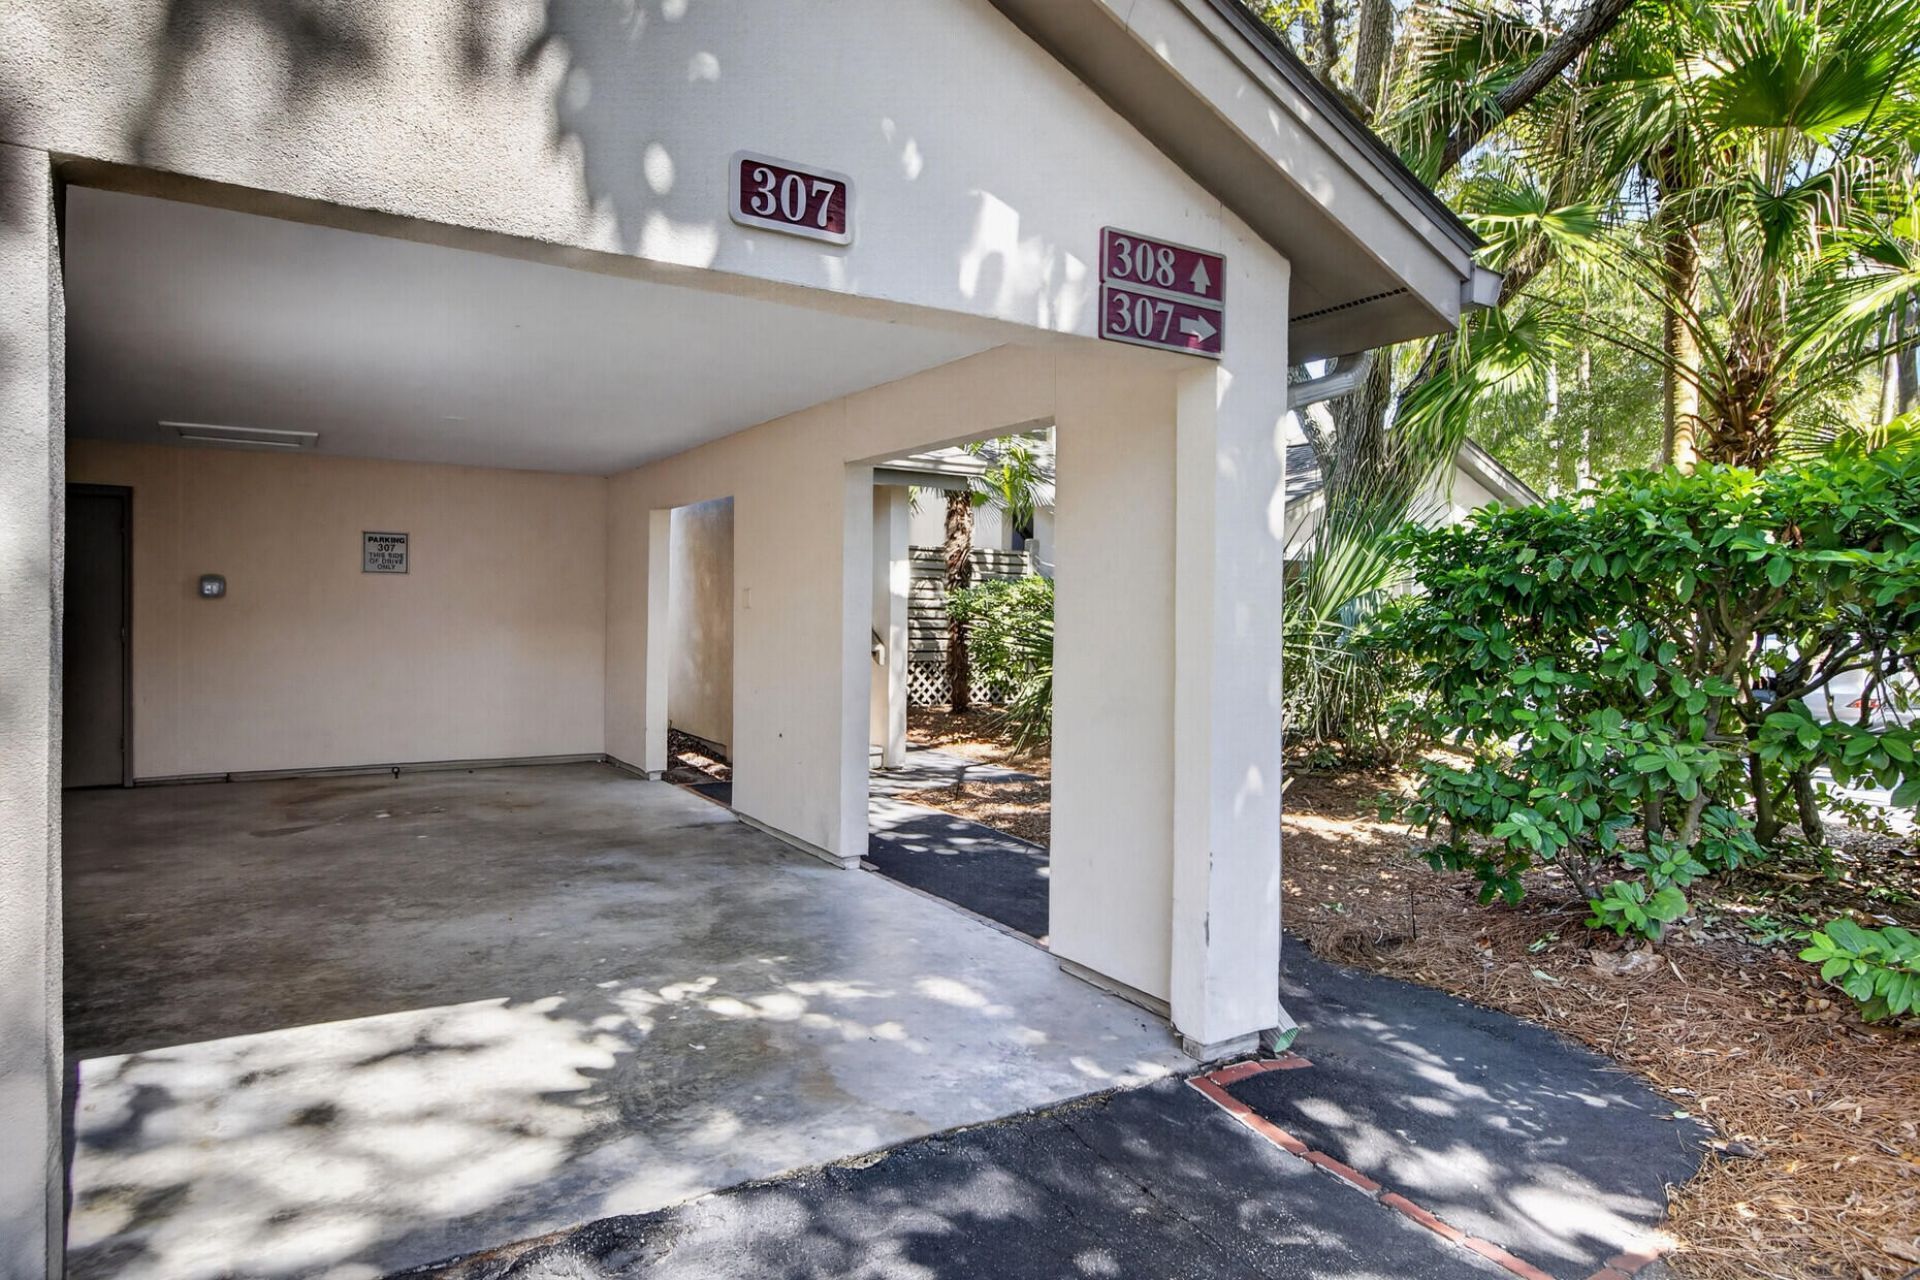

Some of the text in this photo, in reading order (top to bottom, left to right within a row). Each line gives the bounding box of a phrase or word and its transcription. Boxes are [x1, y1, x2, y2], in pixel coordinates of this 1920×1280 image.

[751, 167, 836, 228] 307
[1112, 237, 1176, 287] 308
[1111, 293, 1175, 341] 307
[368, 536, 405, 544] PARKING
[377, 543, 396, 552] 307
